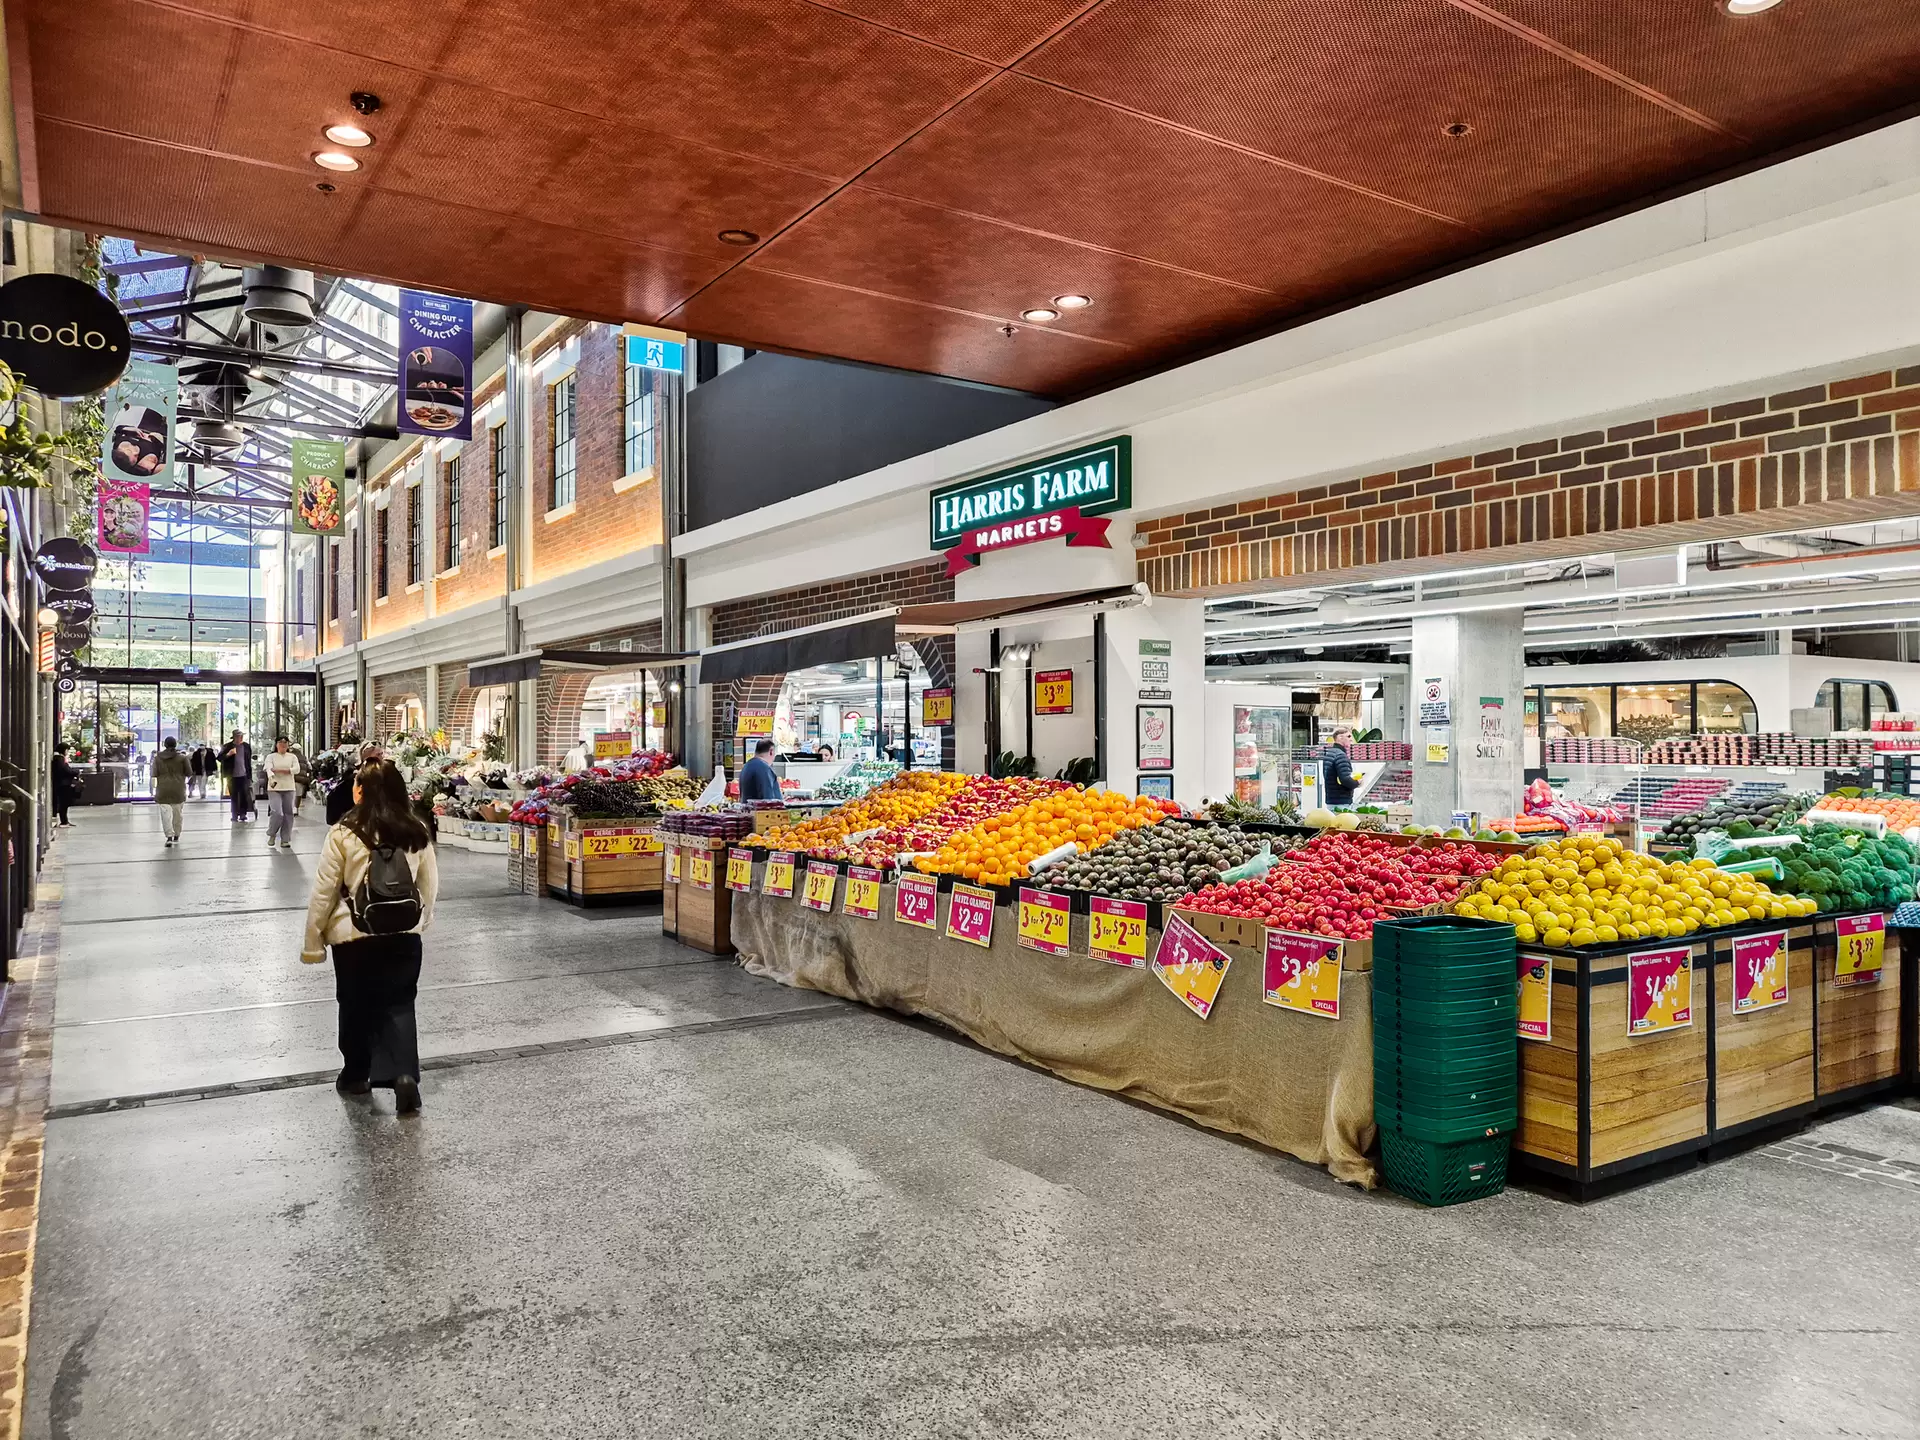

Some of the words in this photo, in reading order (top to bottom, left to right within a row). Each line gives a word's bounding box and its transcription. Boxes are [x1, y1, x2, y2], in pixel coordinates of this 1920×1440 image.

[414, 310, 441, 320] DINING
[1, 320, 118, 352] nodo.
[409, 317, 463, 339] CHARACTER
[300, 455, 338, 470] CHARACTER
[938, 484, 1025, 533] HARRIS
[1031, 460, 1109, 510] FARM
[975, 515, 1063, 548] MARKETS
[1143, 662, 1162, 670] CLICK
[1044, 684, 1065, 704] $3.99
[930, 700, 945, 718] $3.99
[744, 718, 767, 730] $14.99
[1481, 715, 1501, 730] FAMILY
[1476, 744, 1496, 758] SINCE
[589, 837, 619, 853] $22.99
[628, 836, 654, 851] $22.9
[810, 875, 827, 897] $3.99
[852, 882, 870, 904] $3.99
[914, 883, 934, 896] ORANGES
[904, 893, 929, 917] $2.49
[970, 897, 991, 910] ORANGES
[959, 906, 984, 933] $2.49
[1022, 906, 1029, 928] 3
[1031, 915, 1039, 924] for
[1040, 910, 1064, 935] $2.50
[1093, 916, 1102, 940] 3
[1103, 926, 1112, 935] for
[1113, 919, 1141, 946] $2.50
[1019, 935, 1036, 947] SPECIAL
[1281, 938, 1298, 946] Special
[1298, 940, 1319, 949] Imperfect
[1090, 948, 1110, 961] SPECIAL
[1172, 941, 1205, 976] $3.99
[1849, 937, 1874, 969] $3.99
[1631, 958, 1649, 967] Imperfect
[1281, 954, 1320, 988] $3.99
[1748, 956, 1776, 989] $4.99
[1835, 974, 1856, 986] SPECIAL
[1646, 974, 1678, 1009] $4.99
[1315, 1001, 1334, 1011] SPECIAL
[1675, 1012, 1688, 1020] SPECIAL
[1518, 1022, 1543, 1033] SPECIAL
